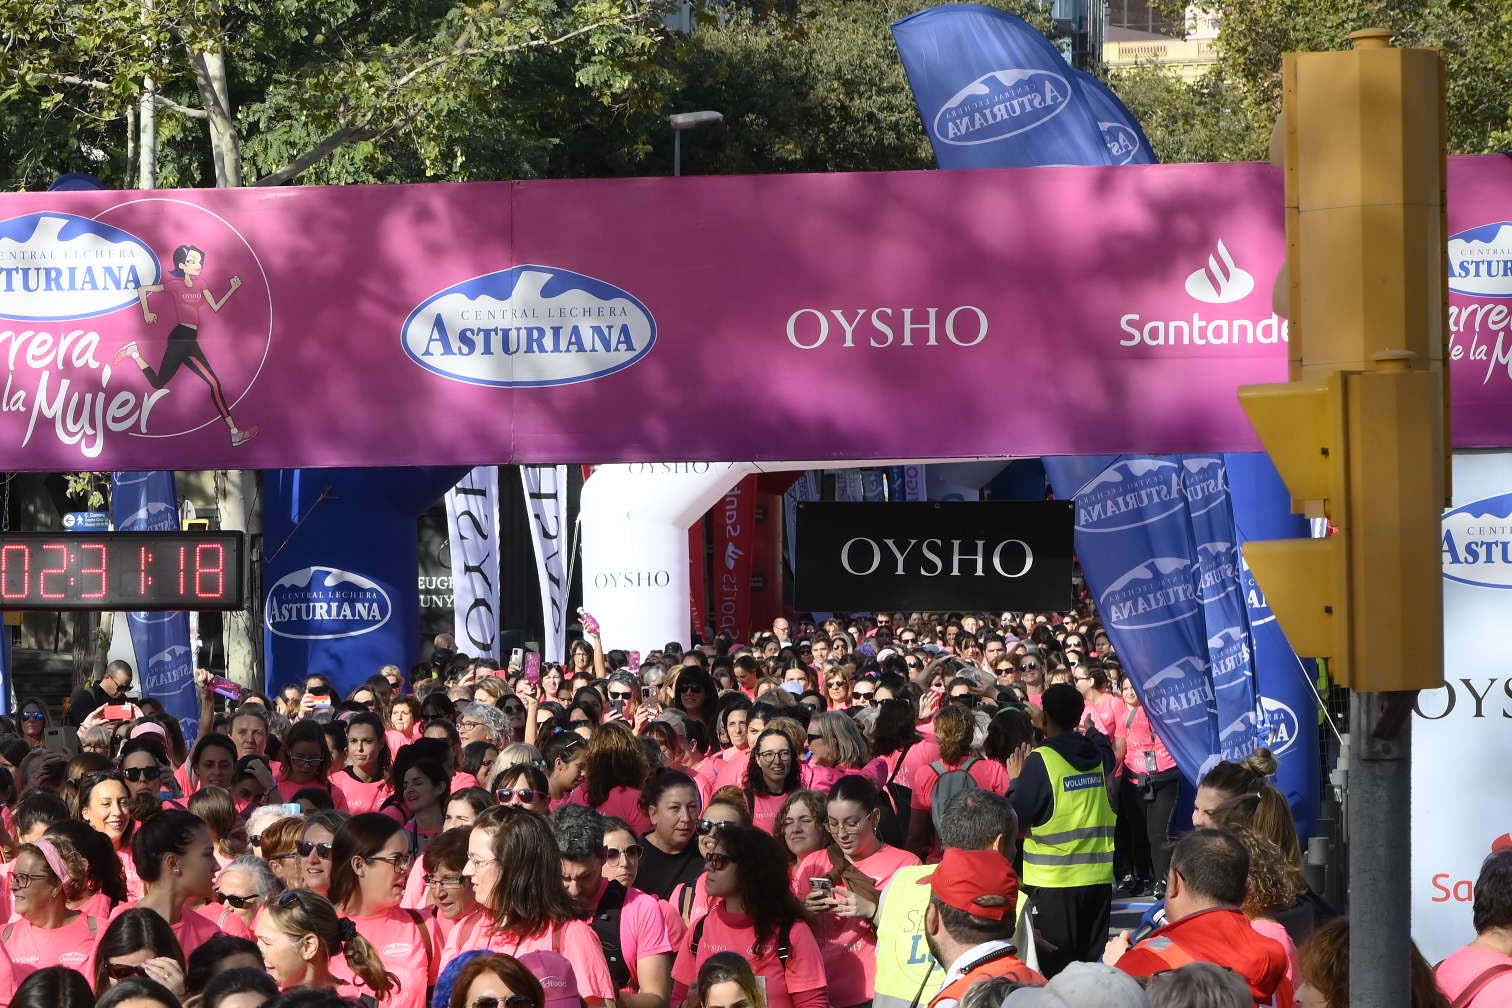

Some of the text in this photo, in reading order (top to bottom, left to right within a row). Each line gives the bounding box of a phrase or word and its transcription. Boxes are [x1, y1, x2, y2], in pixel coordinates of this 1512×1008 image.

[421, 311, 637, 357] ASTURIANA
[460, 305, 629, 321] CENTRAL LECHERA
[786, 305, 990, 349] OYSHO
[1120, 311, 1289, 347] Santand
[2, 372, 27, 414] la
[22, 364, 170, 458] Mujer
[0, 544, 225, 600] 02:31:18
[840, 537, 1034, 579] OYSHO
[593, 569, 670, 590] OYSHO
[269, 594, 382, 624] ASTURIANA
